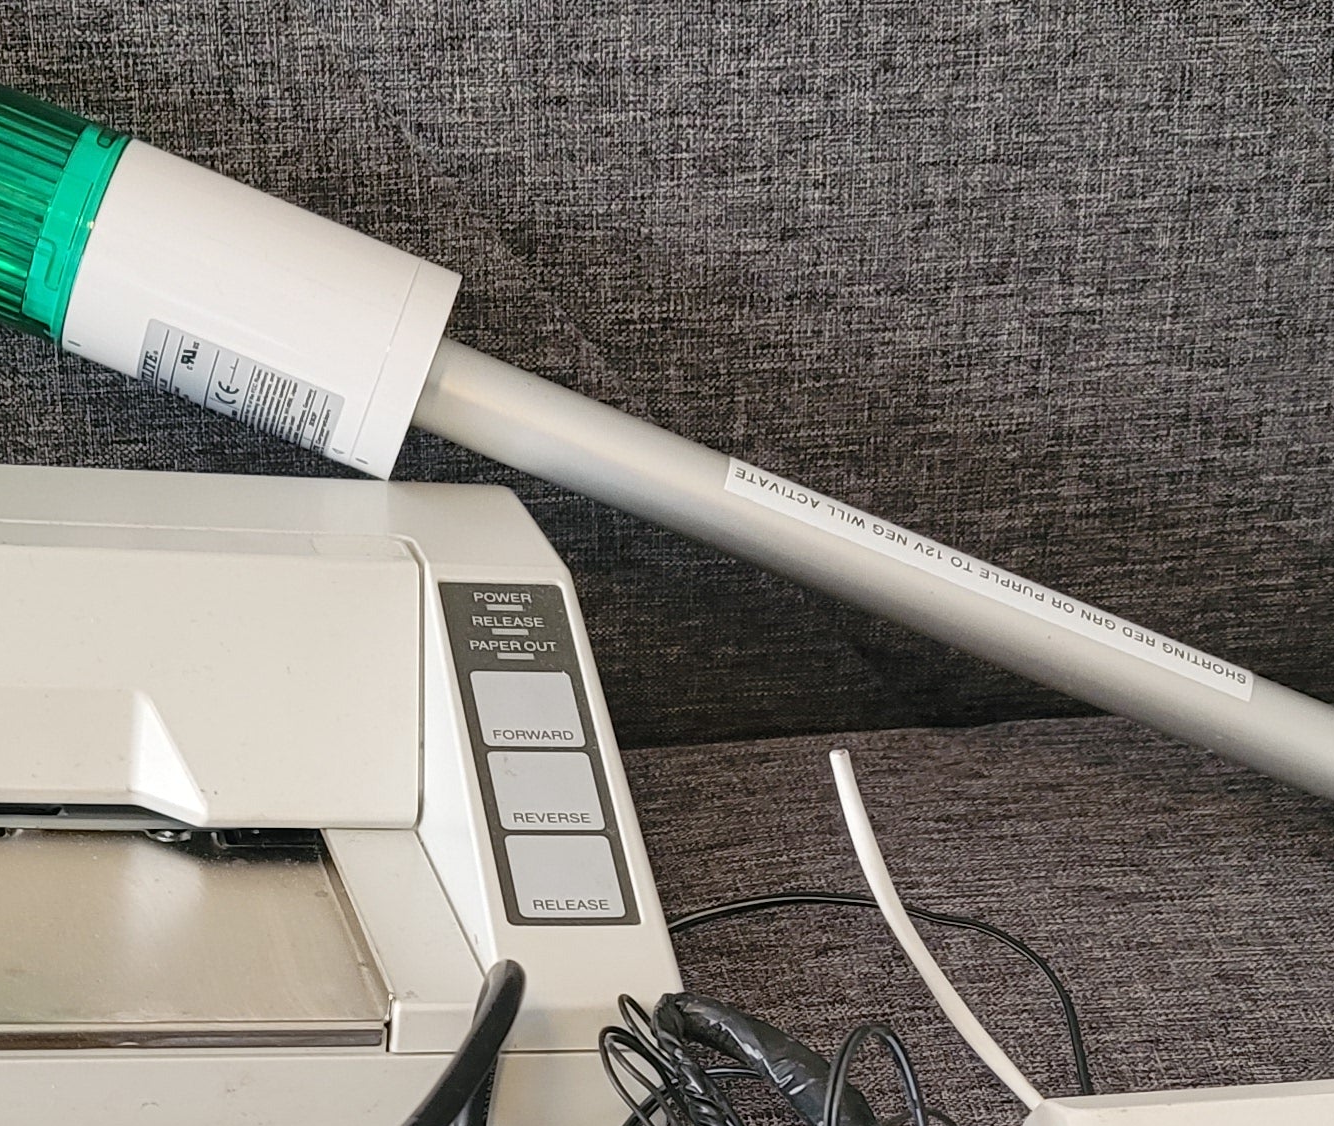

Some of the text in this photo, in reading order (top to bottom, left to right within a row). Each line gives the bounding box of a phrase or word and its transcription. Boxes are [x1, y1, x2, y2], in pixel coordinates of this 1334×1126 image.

[140, 350, 159, 383] TLITE
[735, 467, 1247, 685] SHORTING RED GRN OR PURPLE TO 12V NEG WILL ACTIVATE
[472, 591, 533, 604] POWER
[471, 615, 545, 628] RELEASE
[469, 639, 558, 652] PAPER OUT
[492, 729, 575, 742] FORWARD
[513, 811, 592, 824] REVERSE
[532, 898, 611, 911] RELEASE
